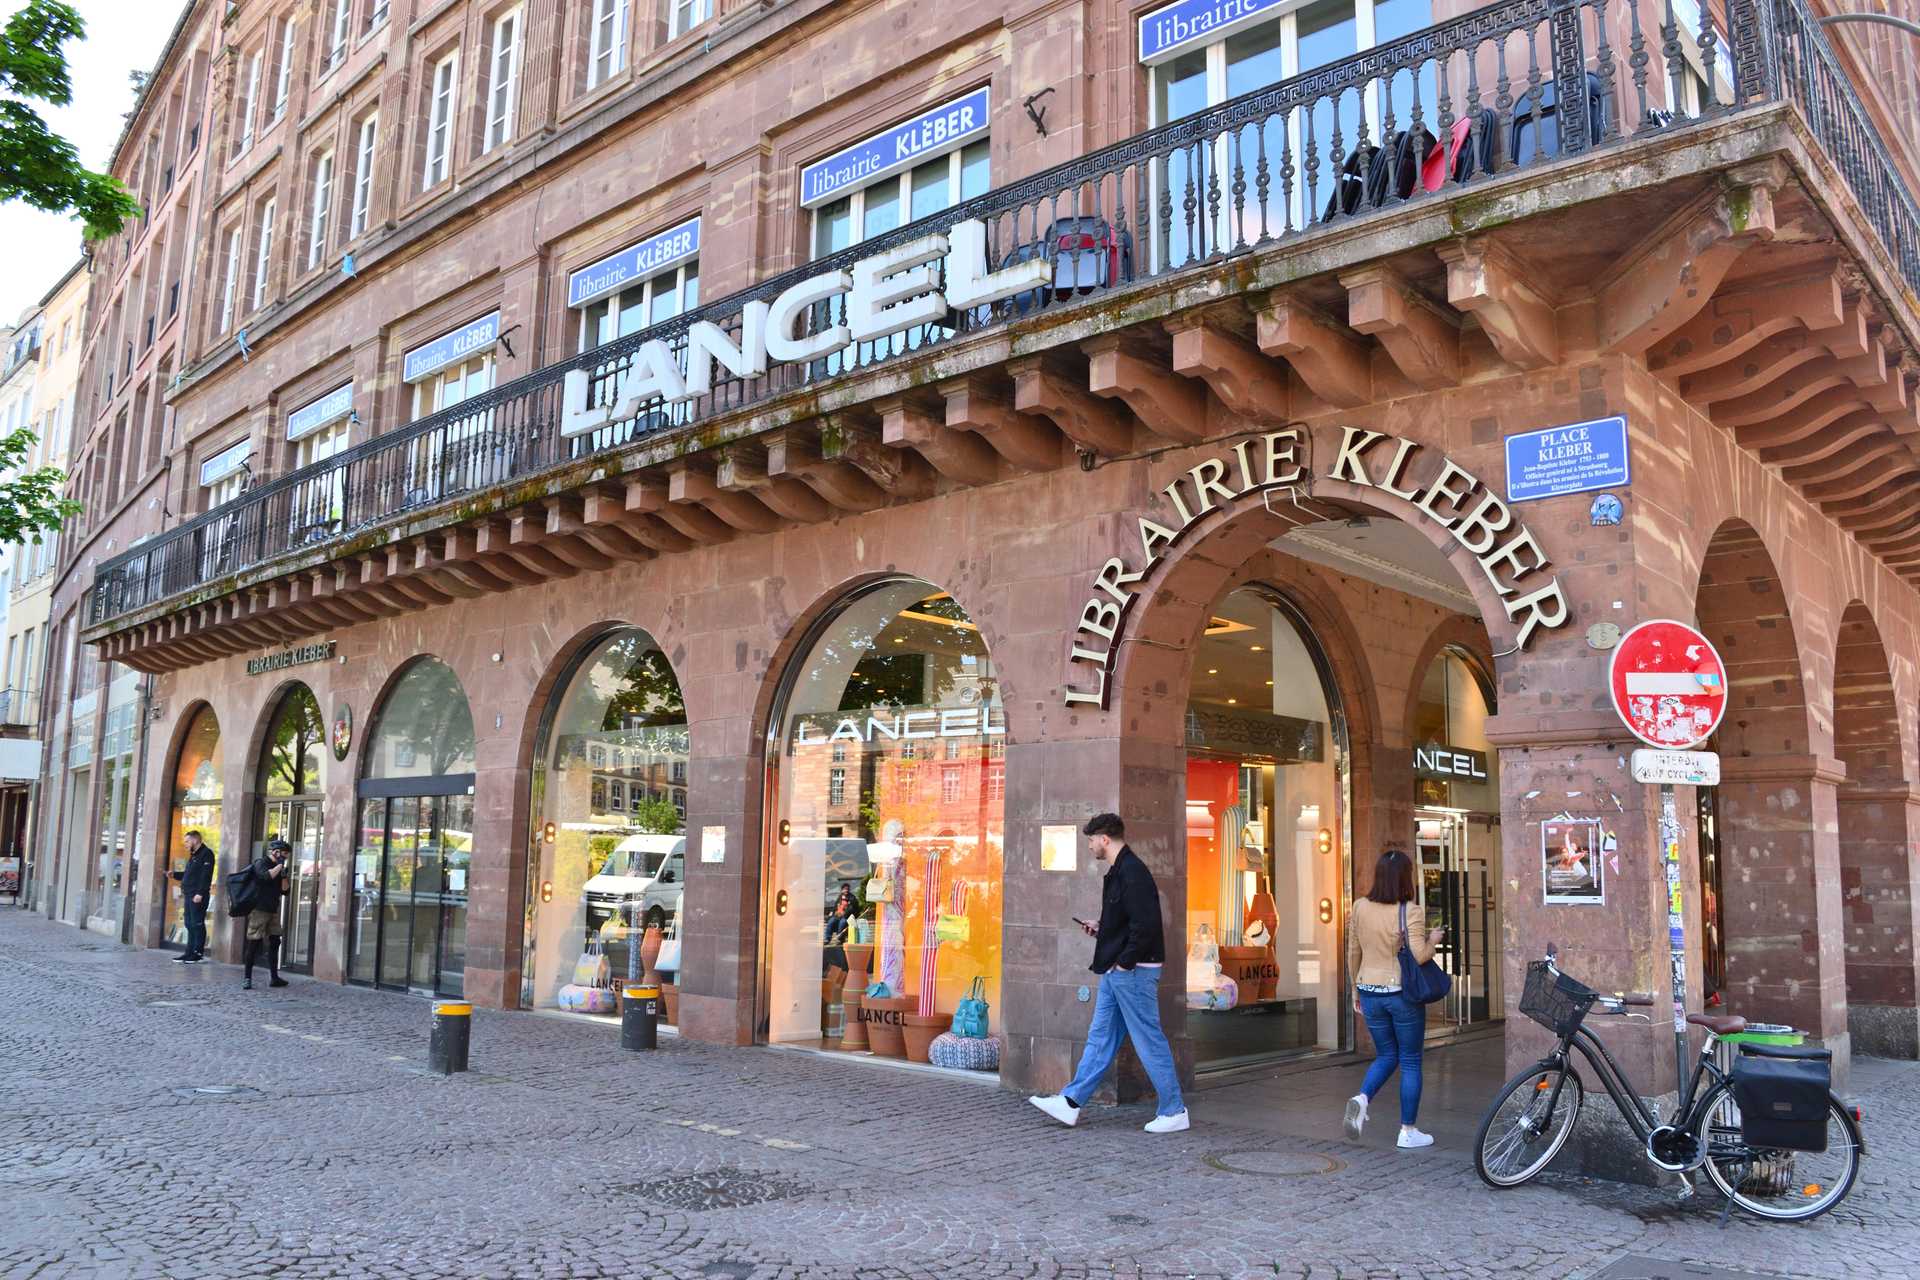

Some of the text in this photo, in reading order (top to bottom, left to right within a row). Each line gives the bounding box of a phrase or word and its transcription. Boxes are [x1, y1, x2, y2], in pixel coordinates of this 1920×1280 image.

[811, 150, 881, 196] librairie
[577, 263, 627, 299] librairie
[560, 218, 1052, 438] LANCEL
[410, 348, 447, 376] librairie
[1538, 441, 1593, 462] KLEBER
[1540, 427, 1590, 448] PLACE
[1064, 425, 1570, 710] LIBRAIRIE KLEBER
[291, 642, 330, 666] KLEBER
[799, 707, 1006, 746] LANCEL
[1413, 747, 1487, 778] NCEL
[1239, 964, 1278, 981] LANCEL
[856, 1007, 908, 1027] LANCEL
